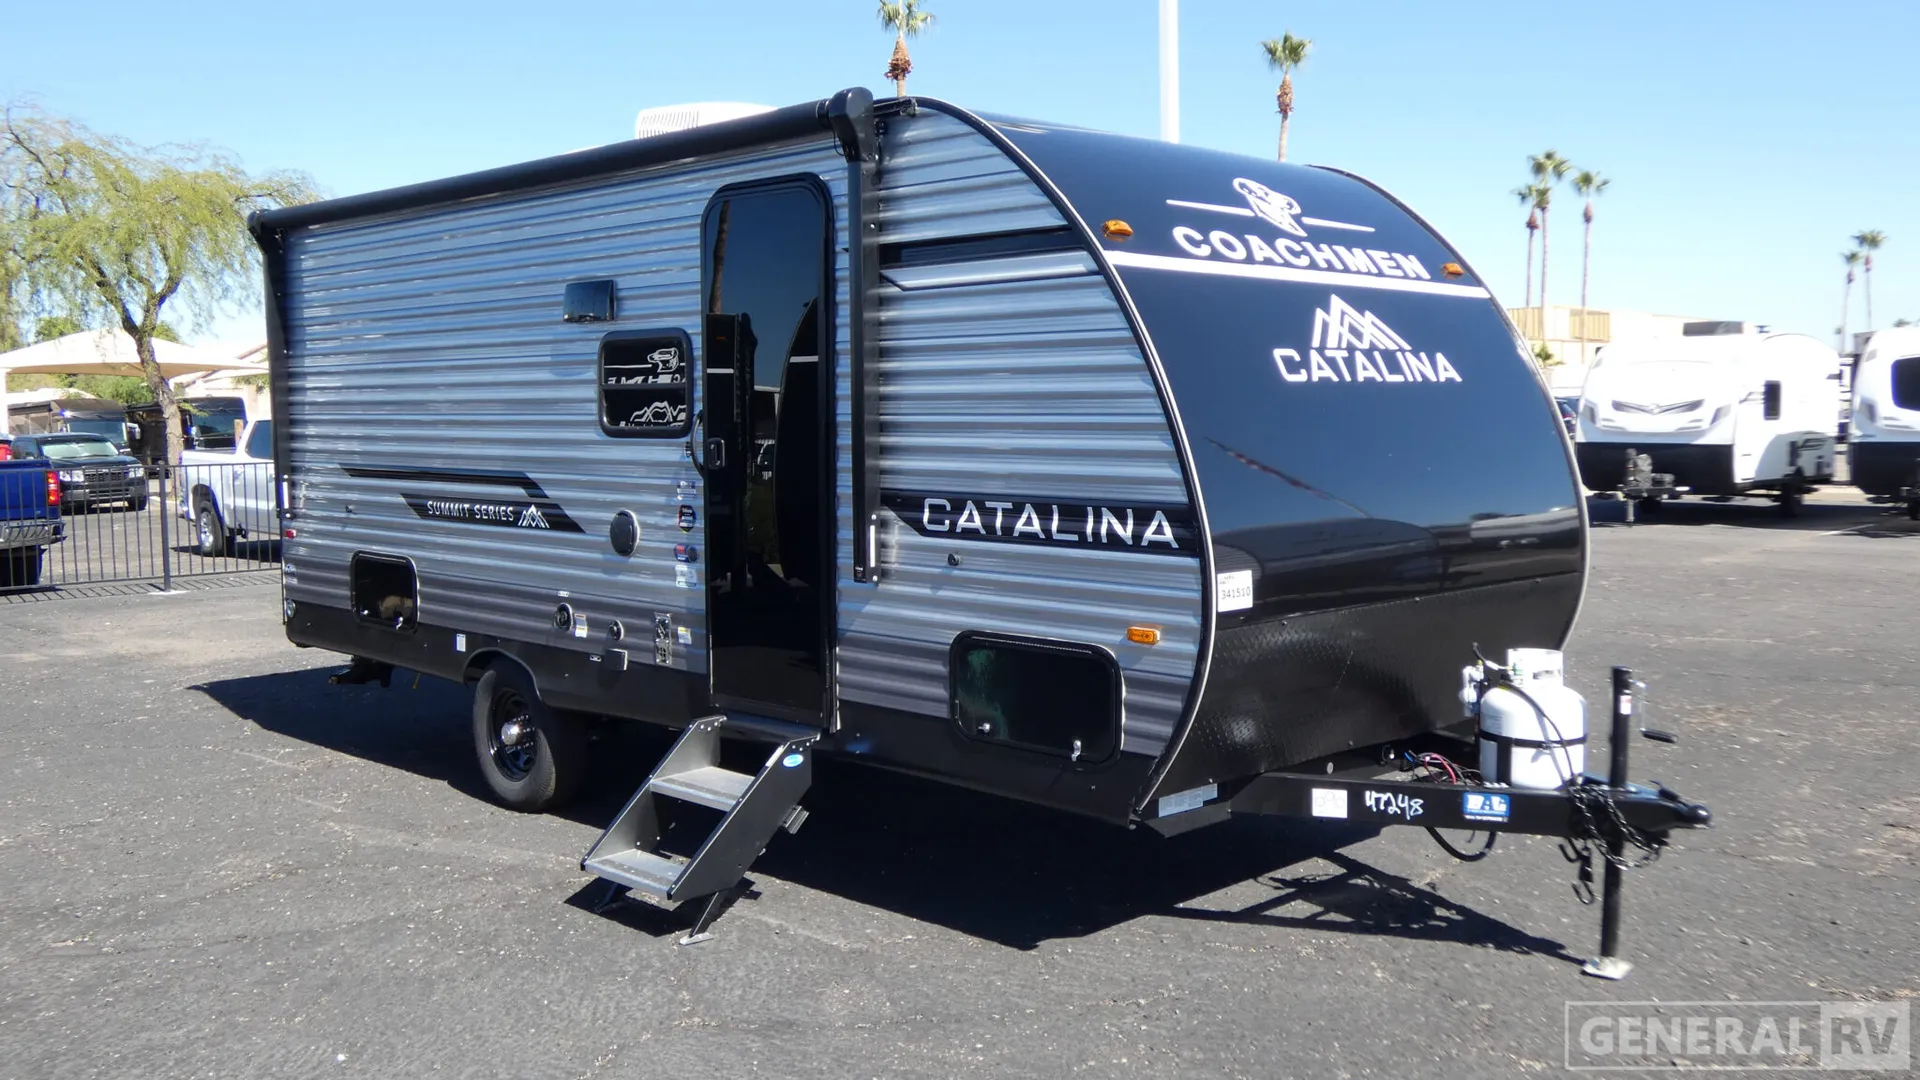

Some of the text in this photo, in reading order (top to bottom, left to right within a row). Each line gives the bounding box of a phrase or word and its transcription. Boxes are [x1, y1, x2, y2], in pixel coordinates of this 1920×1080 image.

[1172, 226, 1431, 280] COACHMEN
[1273, 349, 1463, 383] CATALINA
[427, 500, 514, 521] SUMMIT SERIES
[922, 498, 1180, 549] CATALINA
[1221, 586, 1251, 600] 341510
[1364, 790, 1424, 820] 47248
